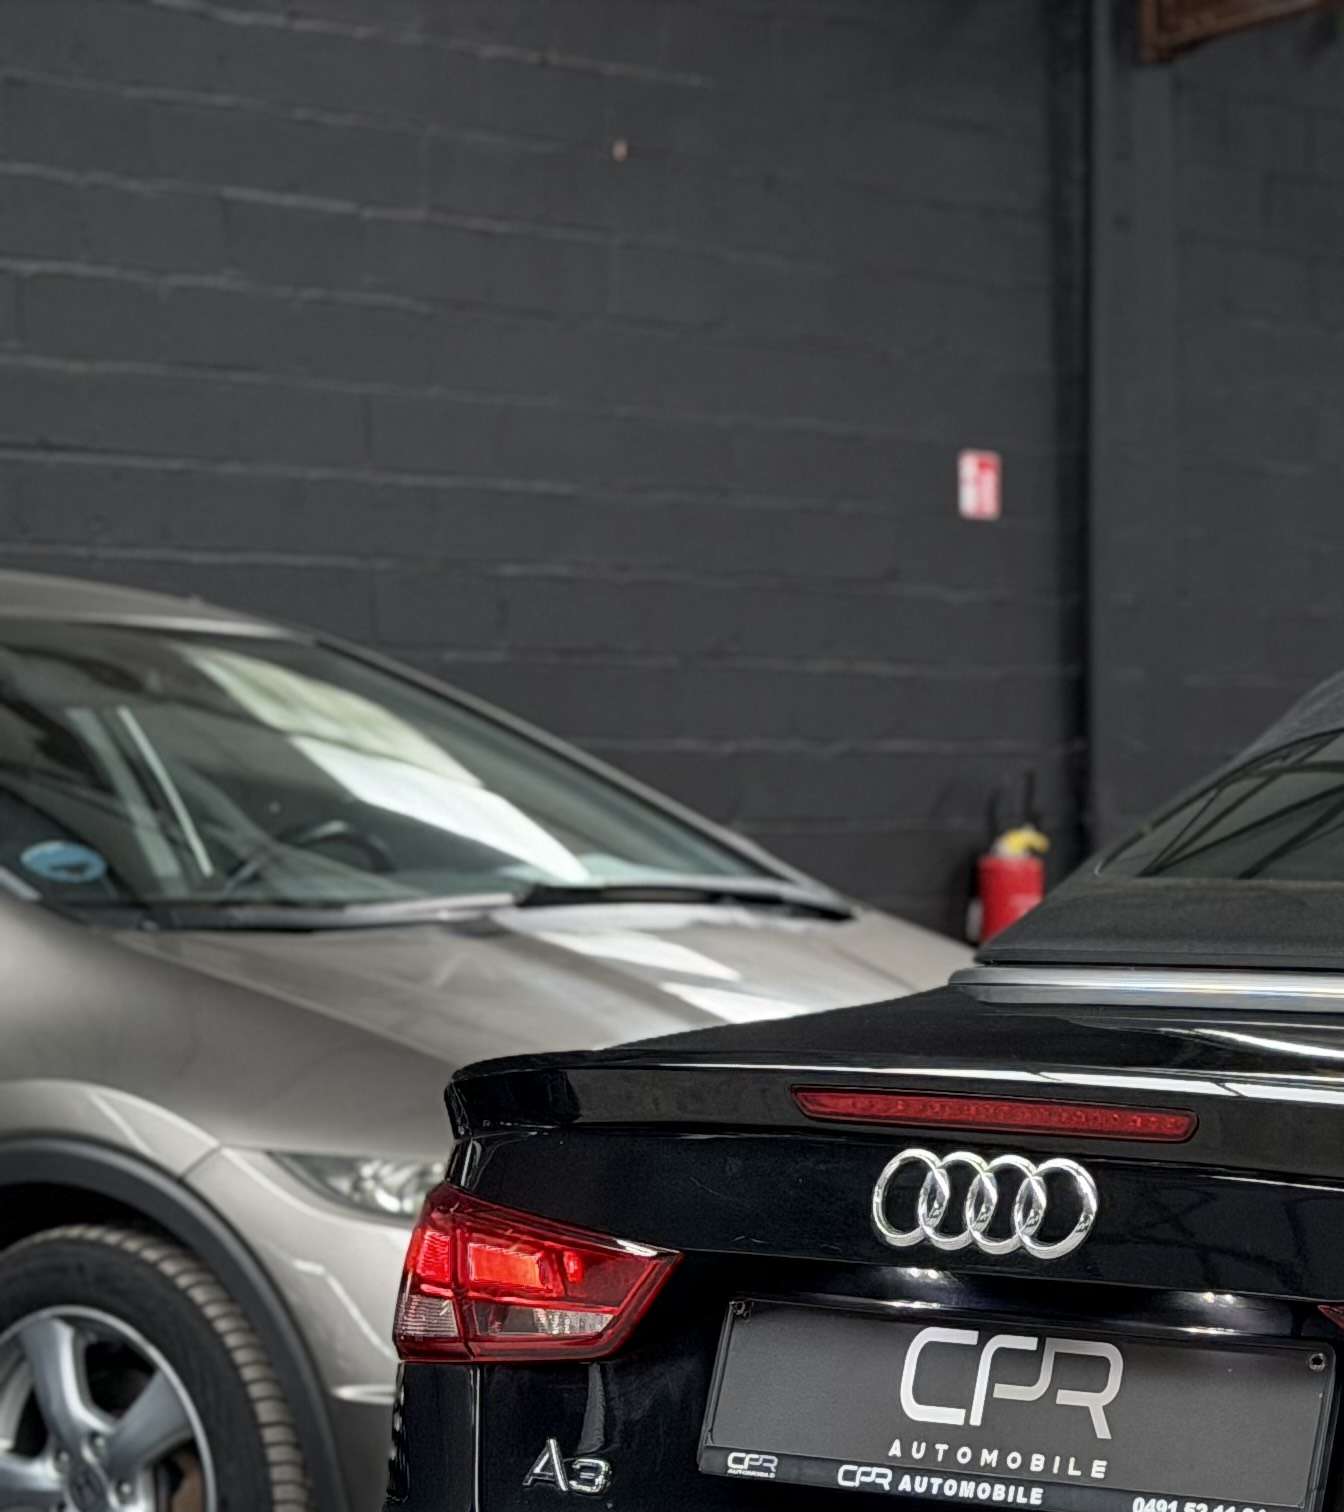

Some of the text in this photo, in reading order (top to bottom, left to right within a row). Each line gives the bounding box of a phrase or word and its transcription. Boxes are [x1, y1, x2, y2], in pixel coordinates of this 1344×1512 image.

[900, 1326, 1124, 1440] CPR
[521, 1437, 609, 1493] A3
[727, 1452, 778, 1473] CPR
[887, 1438, 1109, 1480] AUTOMOBILE
[837, 1464, 1044, 1506] CPR AUTOMOBILE
